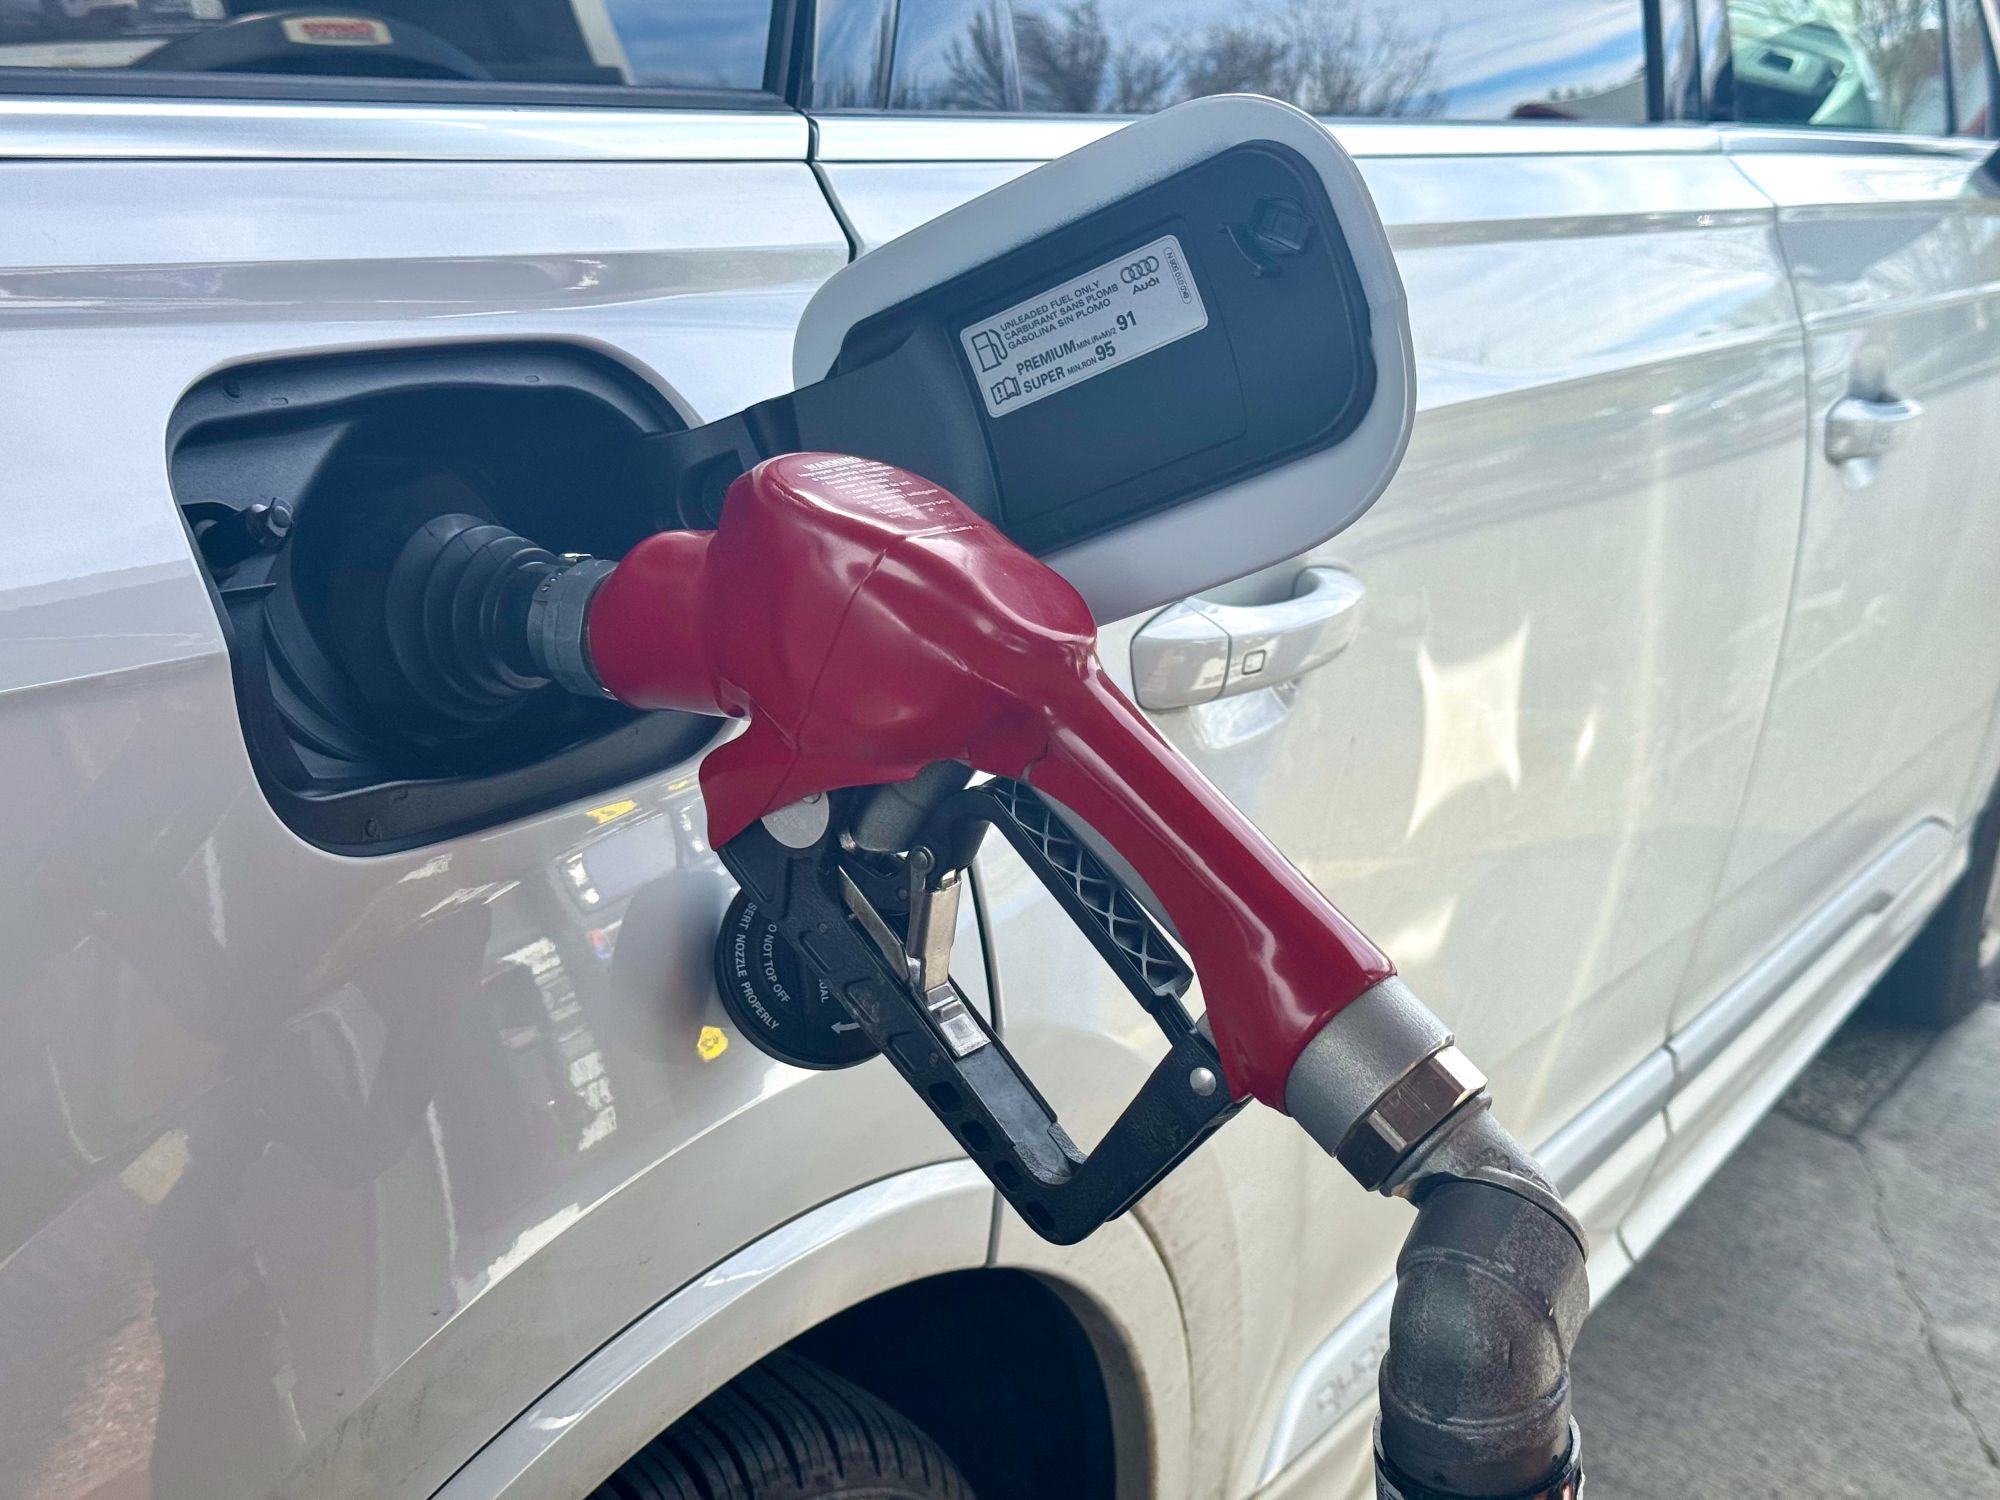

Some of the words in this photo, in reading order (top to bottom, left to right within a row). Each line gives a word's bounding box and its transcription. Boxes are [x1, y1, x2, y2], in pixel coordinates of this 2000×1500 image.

[1001, 304, 1049, 331] UNLEADED
[1049, 295, 1073, 312] FUEL
[1075, 280, 1100, 300] ONLY
[1132, 277, 1159, 295] Audi
[1005, 311, 1059, 340] CARBURANT
[1059, 298, 1085, 318] SANS
[1085, 283, 1119, 308] PLOMB
[1008, 323, 1056, 350] GASOLINA
[1057, 315, 1075, 328] SIN
[1076, 298, 1111, 321] PLOMO
[1016, 339, 1077, 375] PREMIUM
[1116, 311, 1137, 331] 91
[1024, 366, 1065, 393] SUPER
[1095, 341, 1116, 361] 95
[739, 902, 757, 930] SERT
[768, 924, 777, 933] O
[735, 934, 747, 978] NOZZLE
[763, 934, 774, 958] NOT
[764, 959, 777, 981] TOP
[741, 981, 780, 1030] PROPERLY
[773, 983, 791, 1003] OFF
